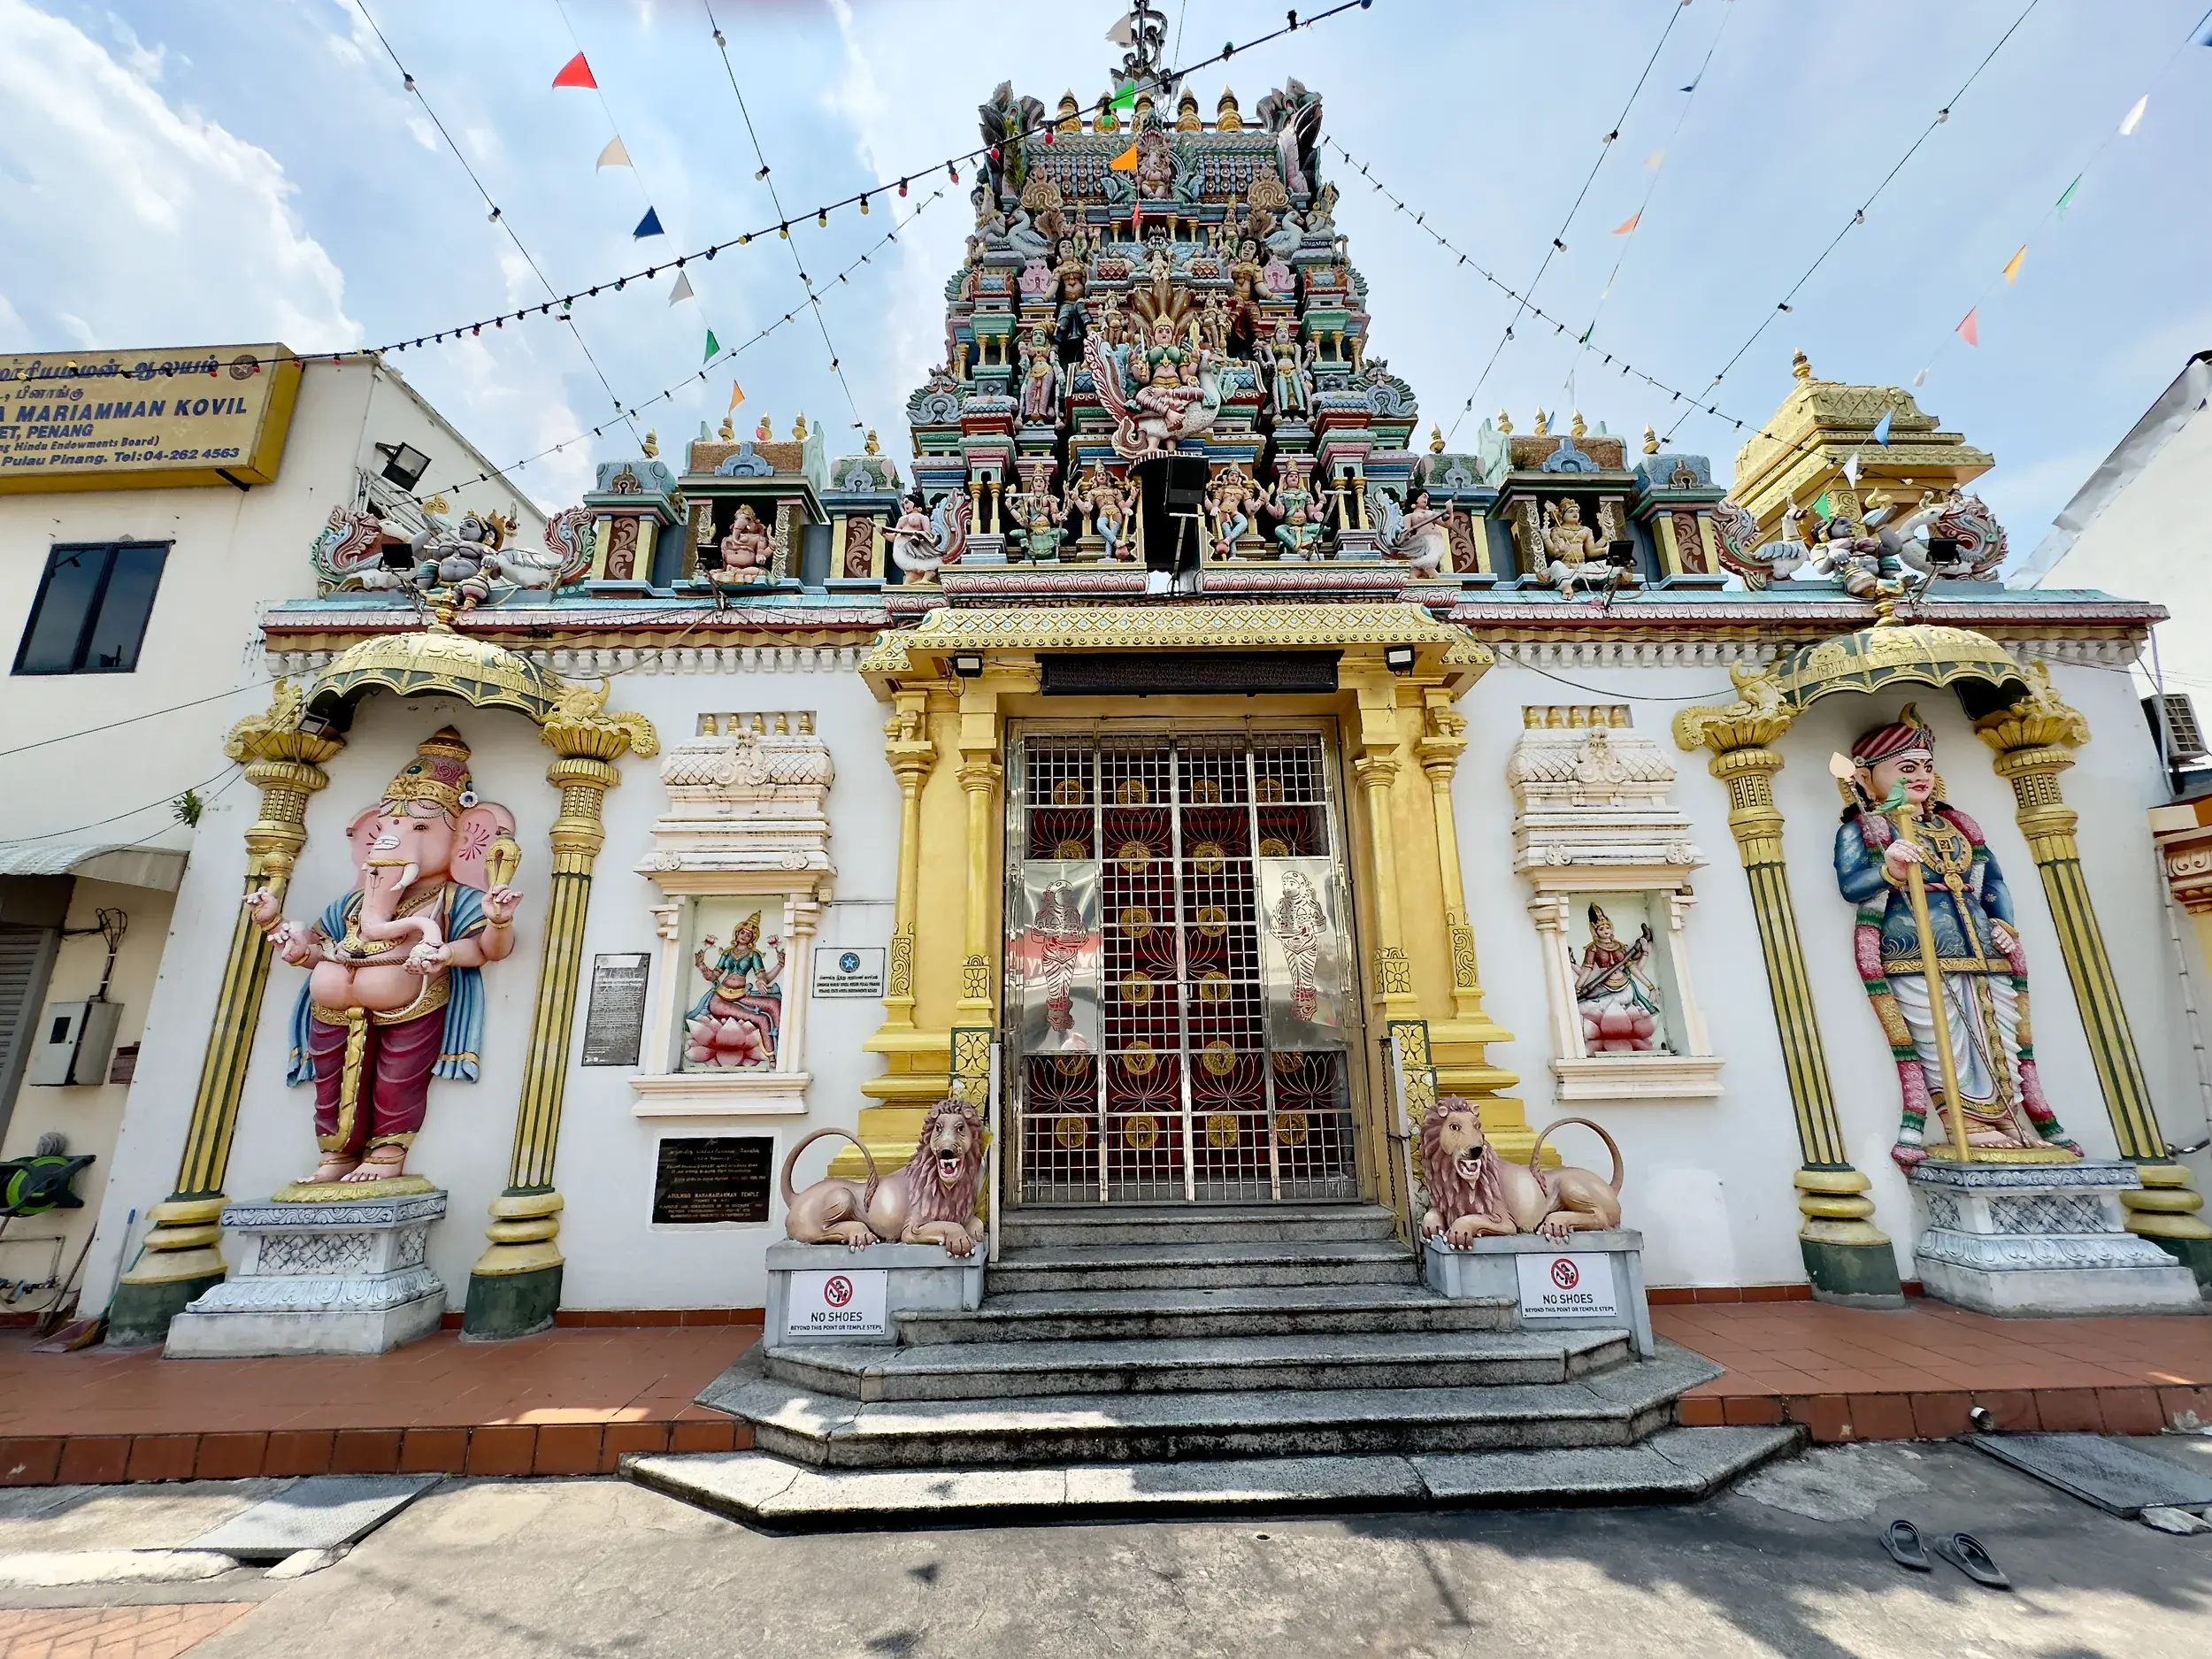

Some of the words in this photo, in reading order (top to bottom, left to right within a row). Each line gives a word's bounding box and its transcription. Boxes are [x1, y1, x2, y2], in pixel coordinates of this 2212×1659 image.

[15, 400, 166, 422] MARIAMMAN
[173, 397, 247, 416] KOVIL
[26, 424, 94, 439] PENANG
[14, 442, 48, 451] Hindu
[50, 439, 119, 449] Endowments
[120, 435, 159, 447] Board)
[1, 456, 46, 466] Pulau
[49, 454, 108, 465] Pinang.
[114, 449, 199, 462] Tel:04-262
[201, 447, 240, 459] 4563
[1543, 1294, 1557, 1304] NO
[1560, 1294, 1594, 1304] SHOES
[811, 1312, 826, 1322] NO
[828, 1311, 863, 1322] SHOES
